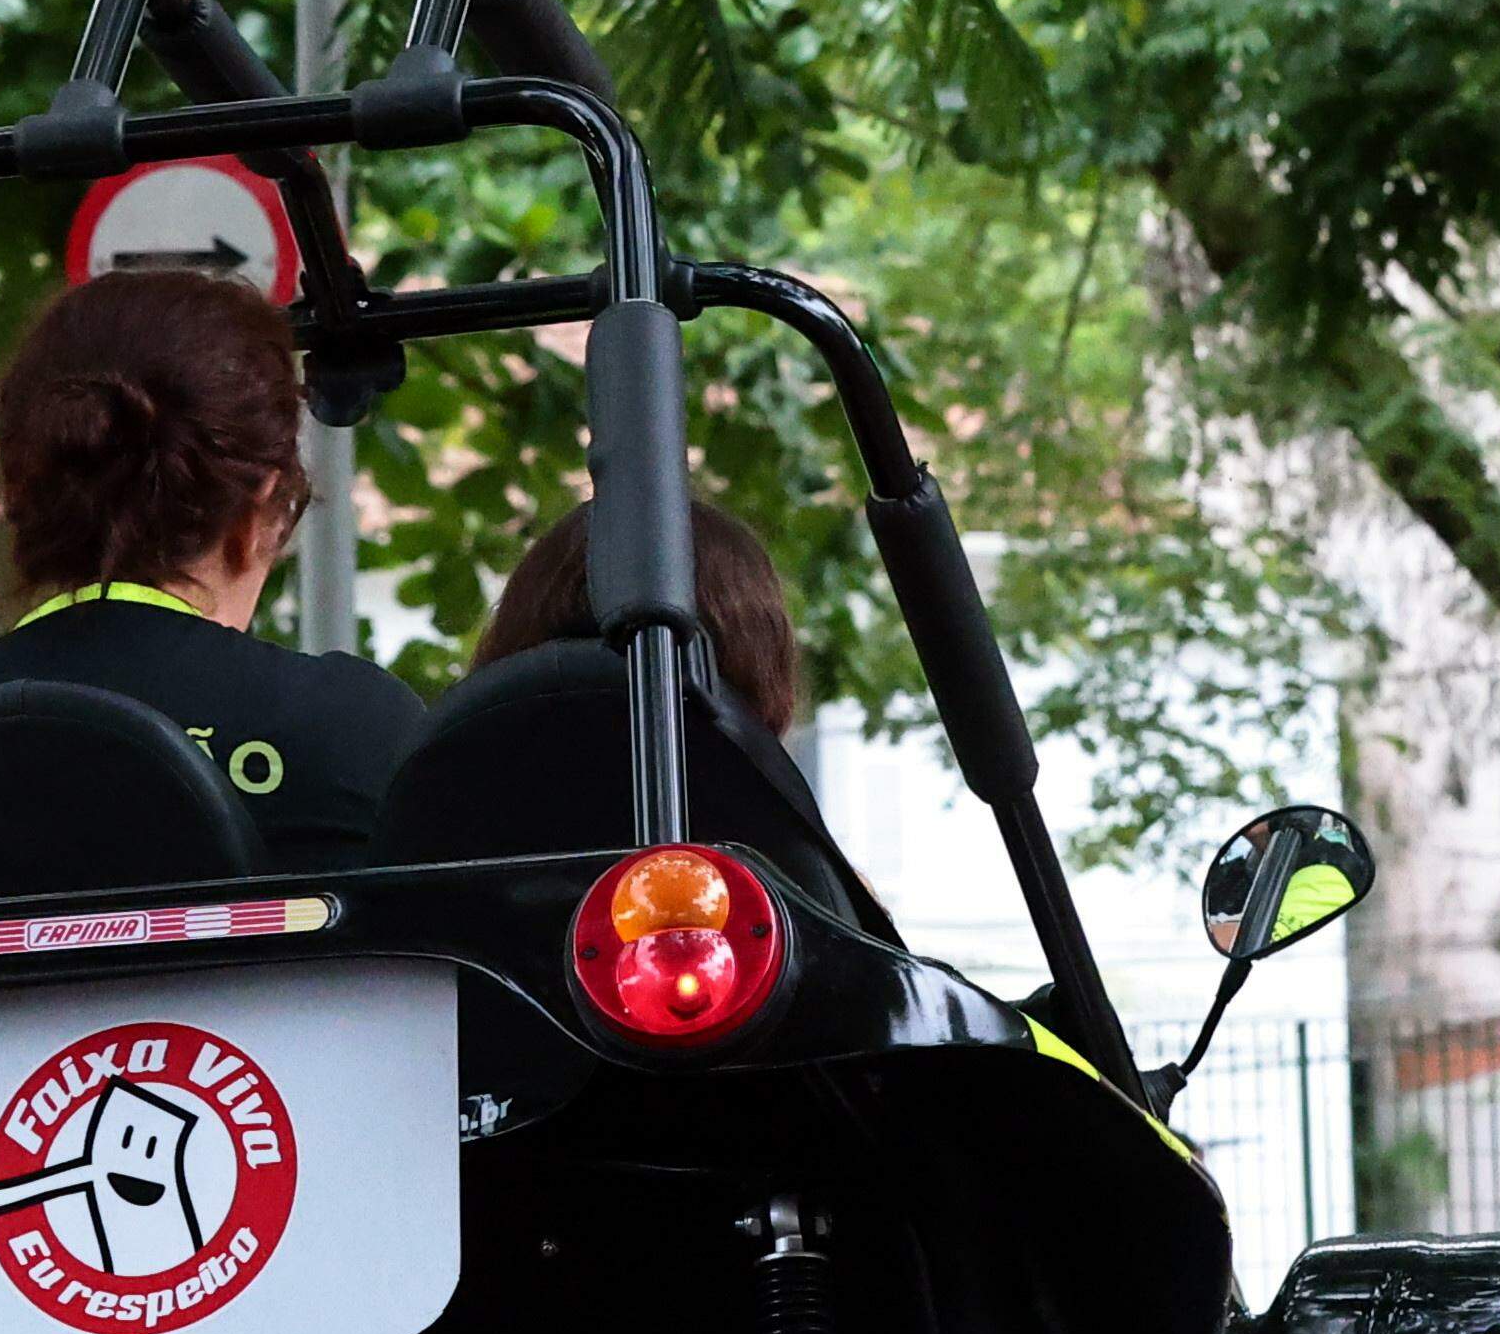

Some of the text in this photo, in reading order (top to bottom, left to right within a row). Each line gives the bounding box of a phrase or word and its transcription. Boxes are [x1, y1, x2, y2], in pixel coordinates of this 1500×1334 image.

[34, 919, 139, 943] FAPINHA
[4, 1039, 282, 1170] Faixa Viva
[8, 1227, 259, 1327] Eu respeito
